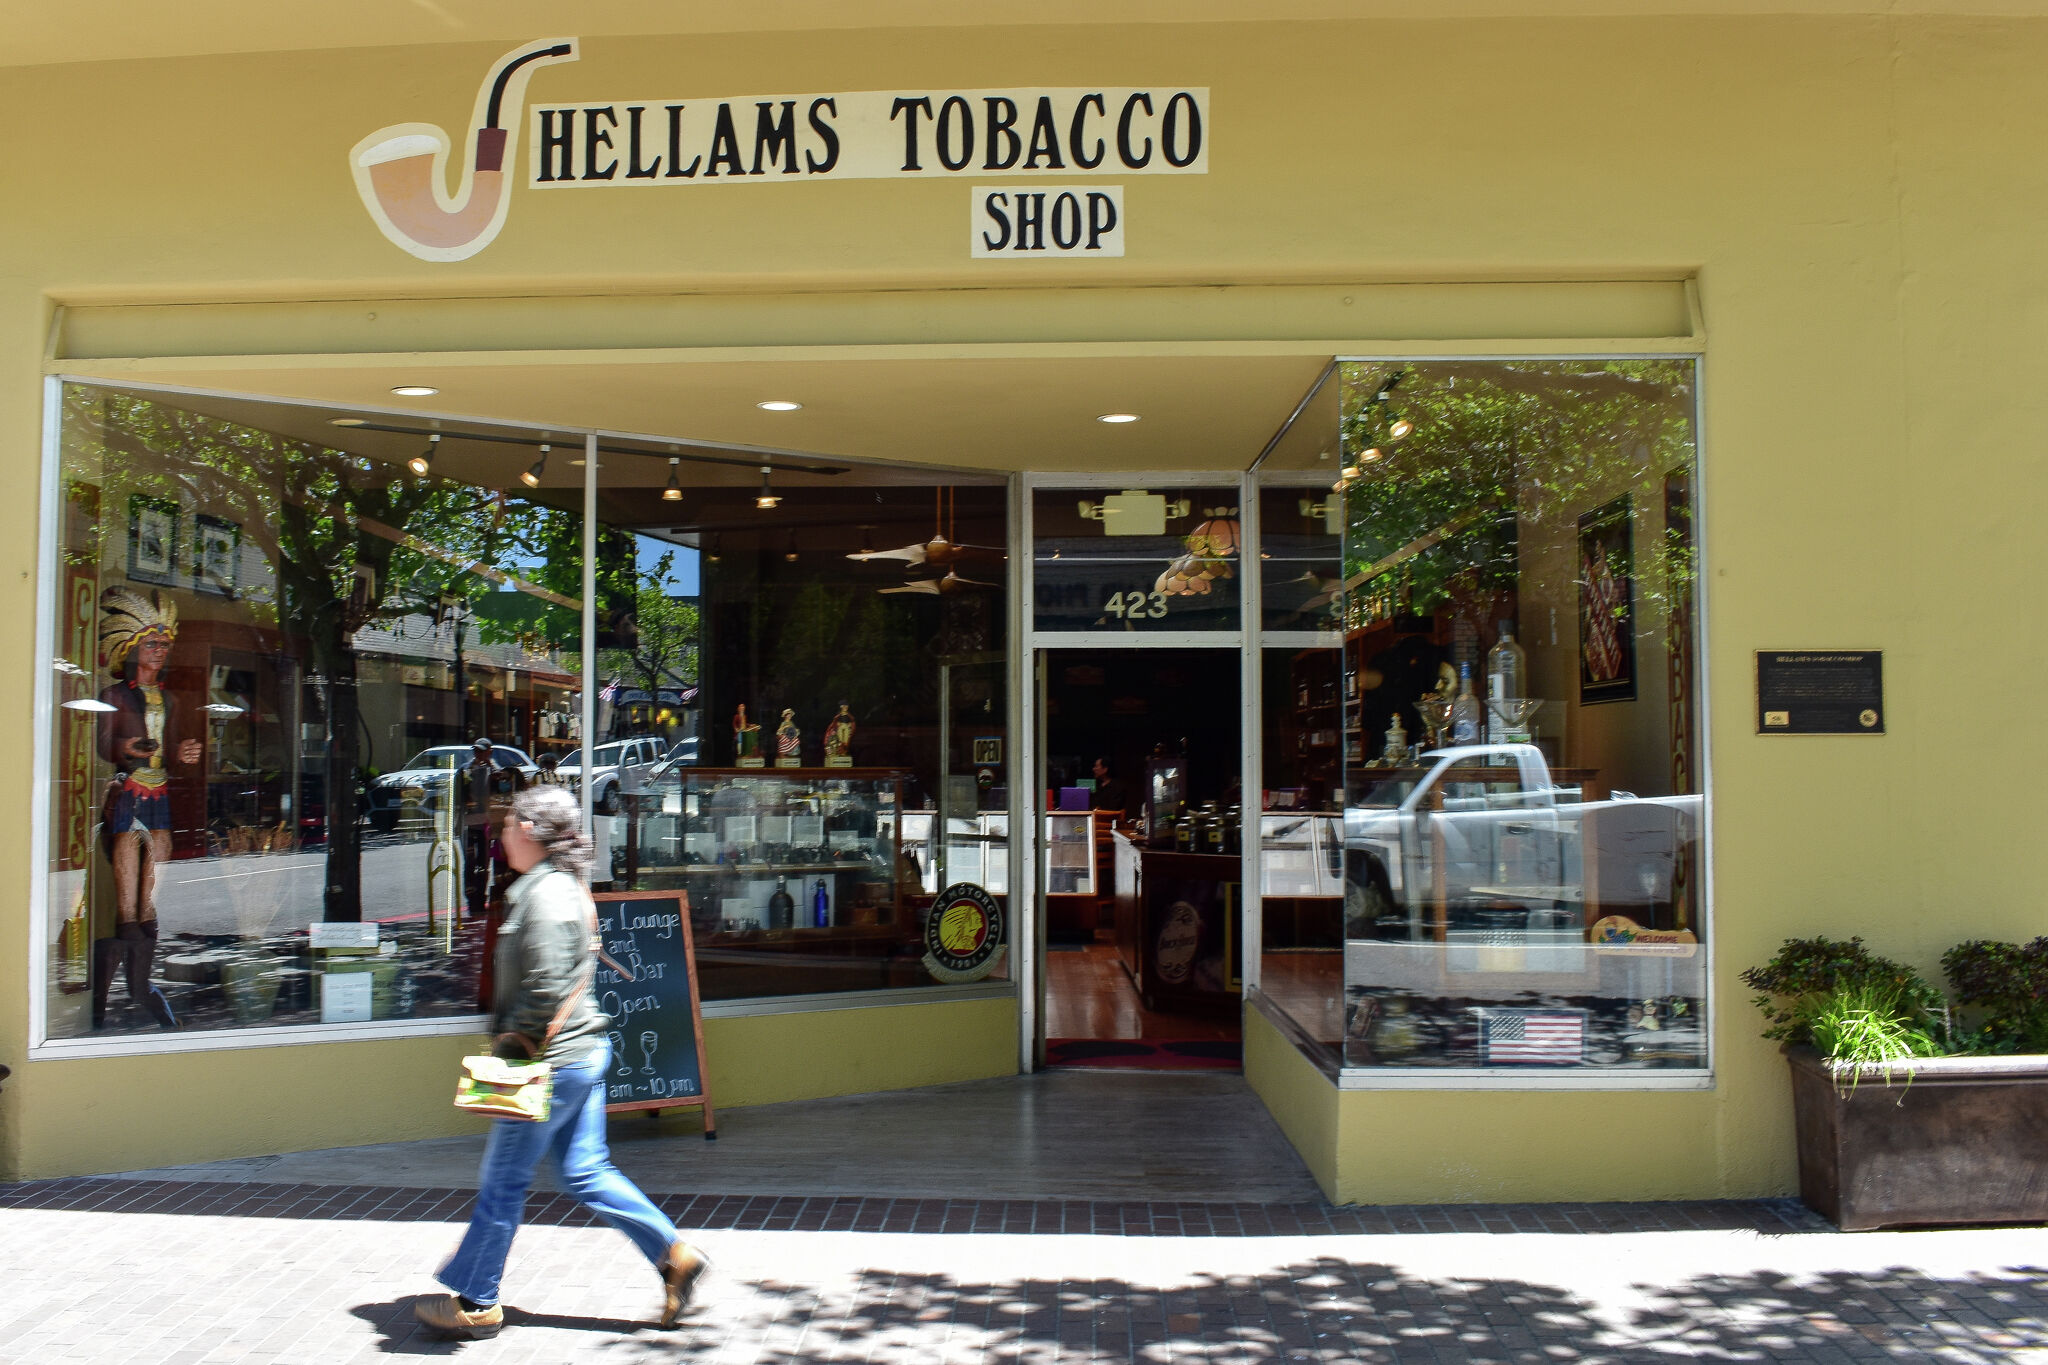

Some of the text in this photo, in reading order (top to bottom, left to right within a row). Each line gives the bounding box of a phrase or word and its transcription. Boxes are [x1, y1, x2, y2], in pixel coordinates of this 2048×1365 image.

[537, 93, 1201, 183] HELLAMS TOBACCO
[982, 192, 1117, 251] SHOP
[1104, 591, 1168, 619] 423
[619, 902, 679, 939] Lounge
[928, 887, 999, 955] INDIAN MOTORCYCLE
[1635, 934, 1679, 944] WELCOME
[609, 932, 640, 955] and
[628, 952, 667, 982] Bar
[602, 990, 661, 1028] Open
